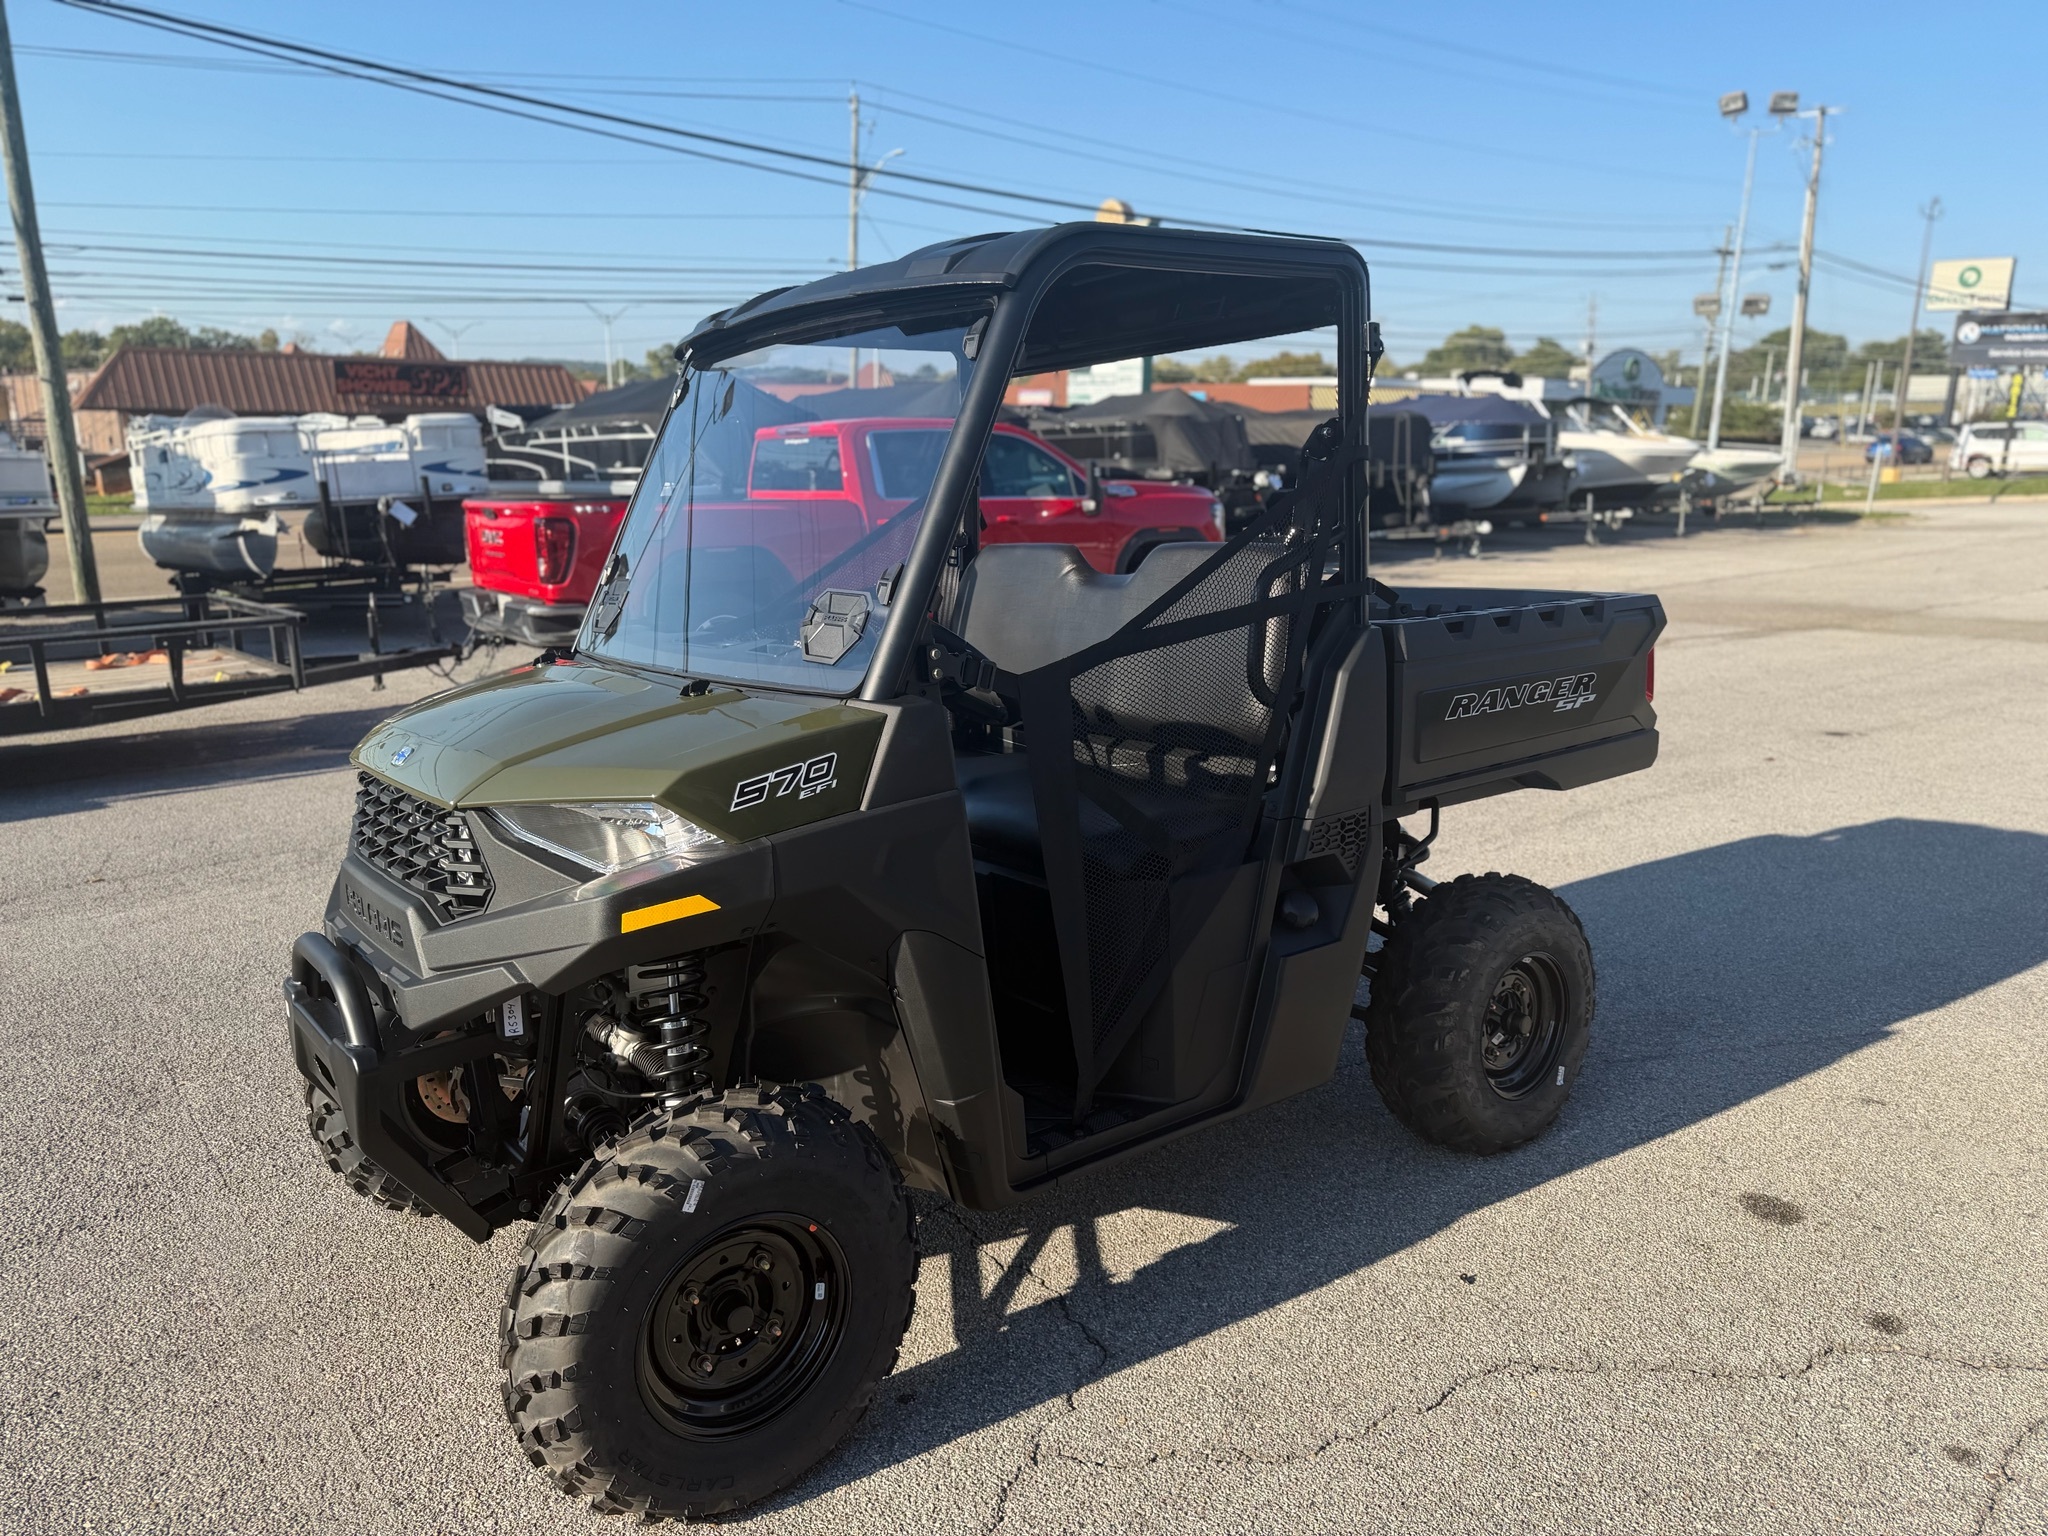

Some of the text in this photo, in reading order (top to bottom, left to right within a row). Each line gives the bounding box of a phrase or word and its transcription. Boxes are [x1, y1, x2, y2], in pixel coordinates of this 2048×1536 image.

[1445, 672, 1597, 721] RANGER
[1553, 694, 1597, 713] SP
[729, 752, 838, 812] 570
[799, 779, 837, 800] EFI
[345, 883, 404, 949] POLARIS
[617, 1448, 735, 1493] CARLSTAR
